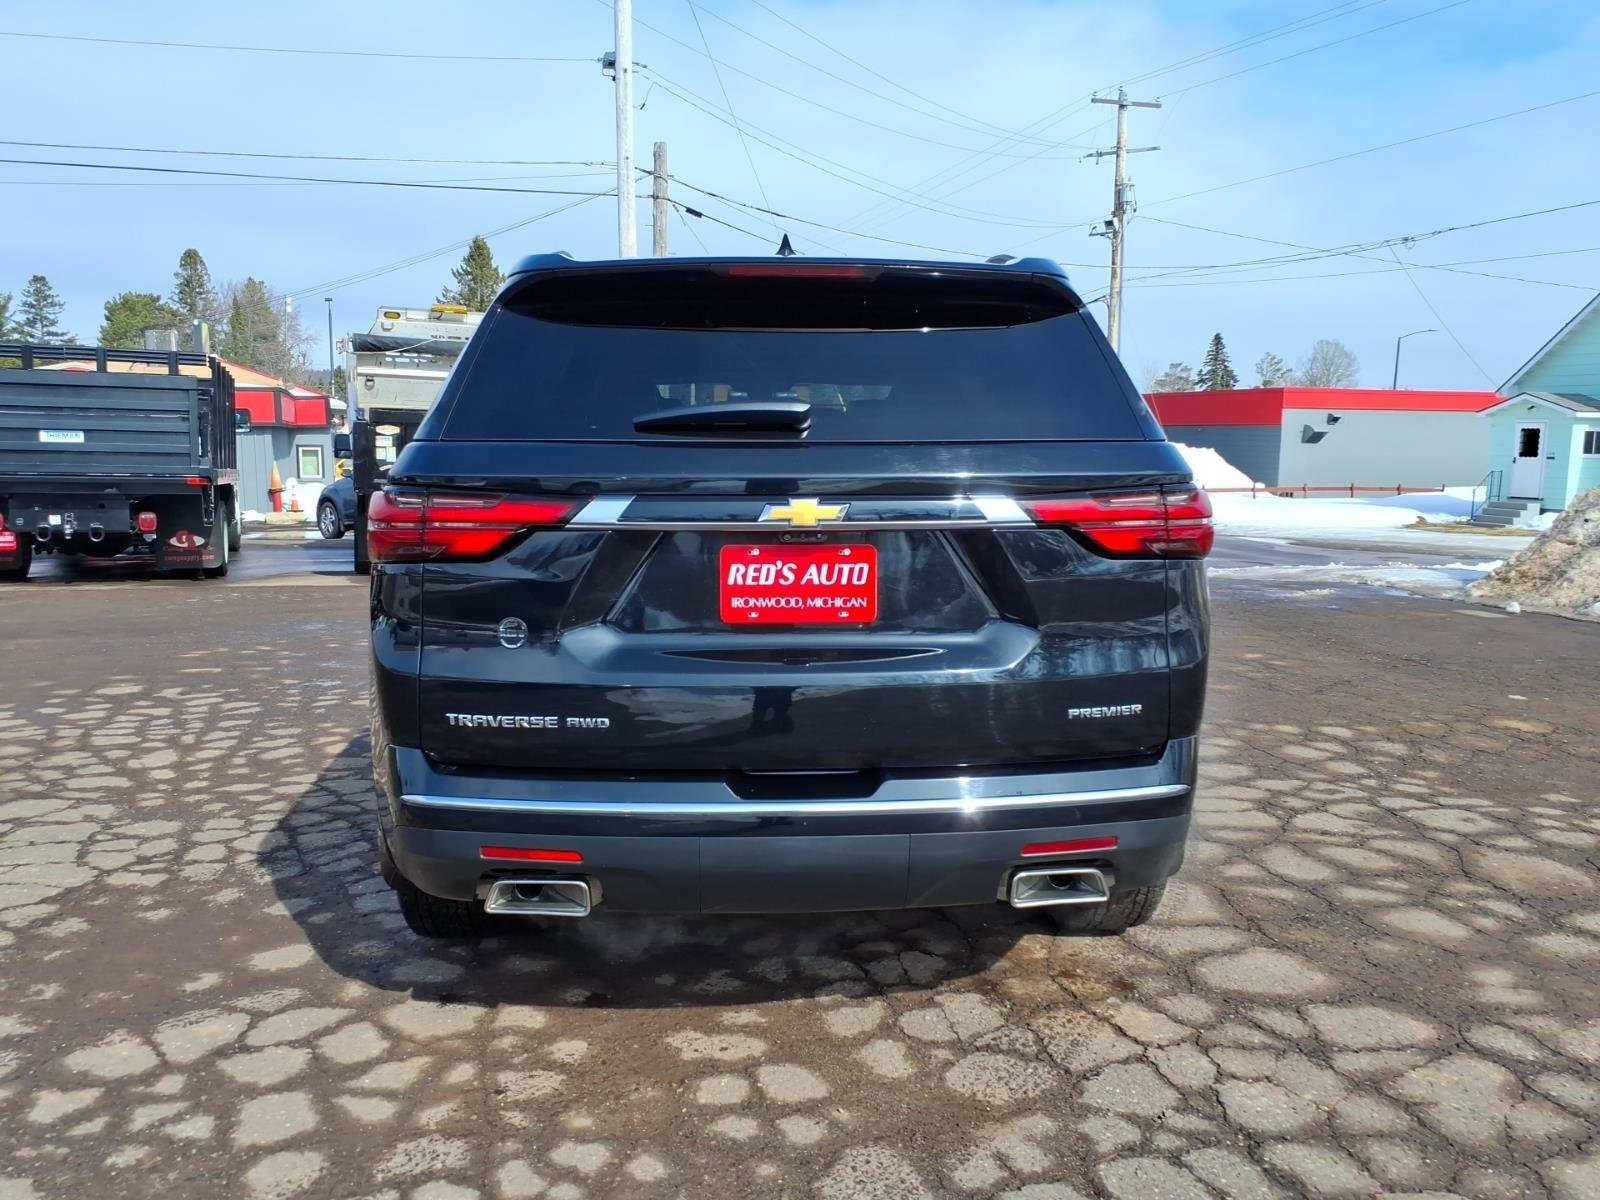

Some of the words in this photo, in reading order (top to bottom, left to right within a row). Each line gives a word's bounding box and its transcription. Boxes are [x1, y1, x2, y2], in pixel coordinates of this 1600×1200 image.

[727, 560, 798, 586] RED'S
[800, 563, 870, 586] AUTO
[731, 597, 805, 609] IRONWOOD,
[807, 597, 867, 608] MICHIGAN
[1067, 704, 1143, 719] PREMIER
[445, 713, 559, 728] TRAVERSE
[566, 717, 610, 728] AWD
